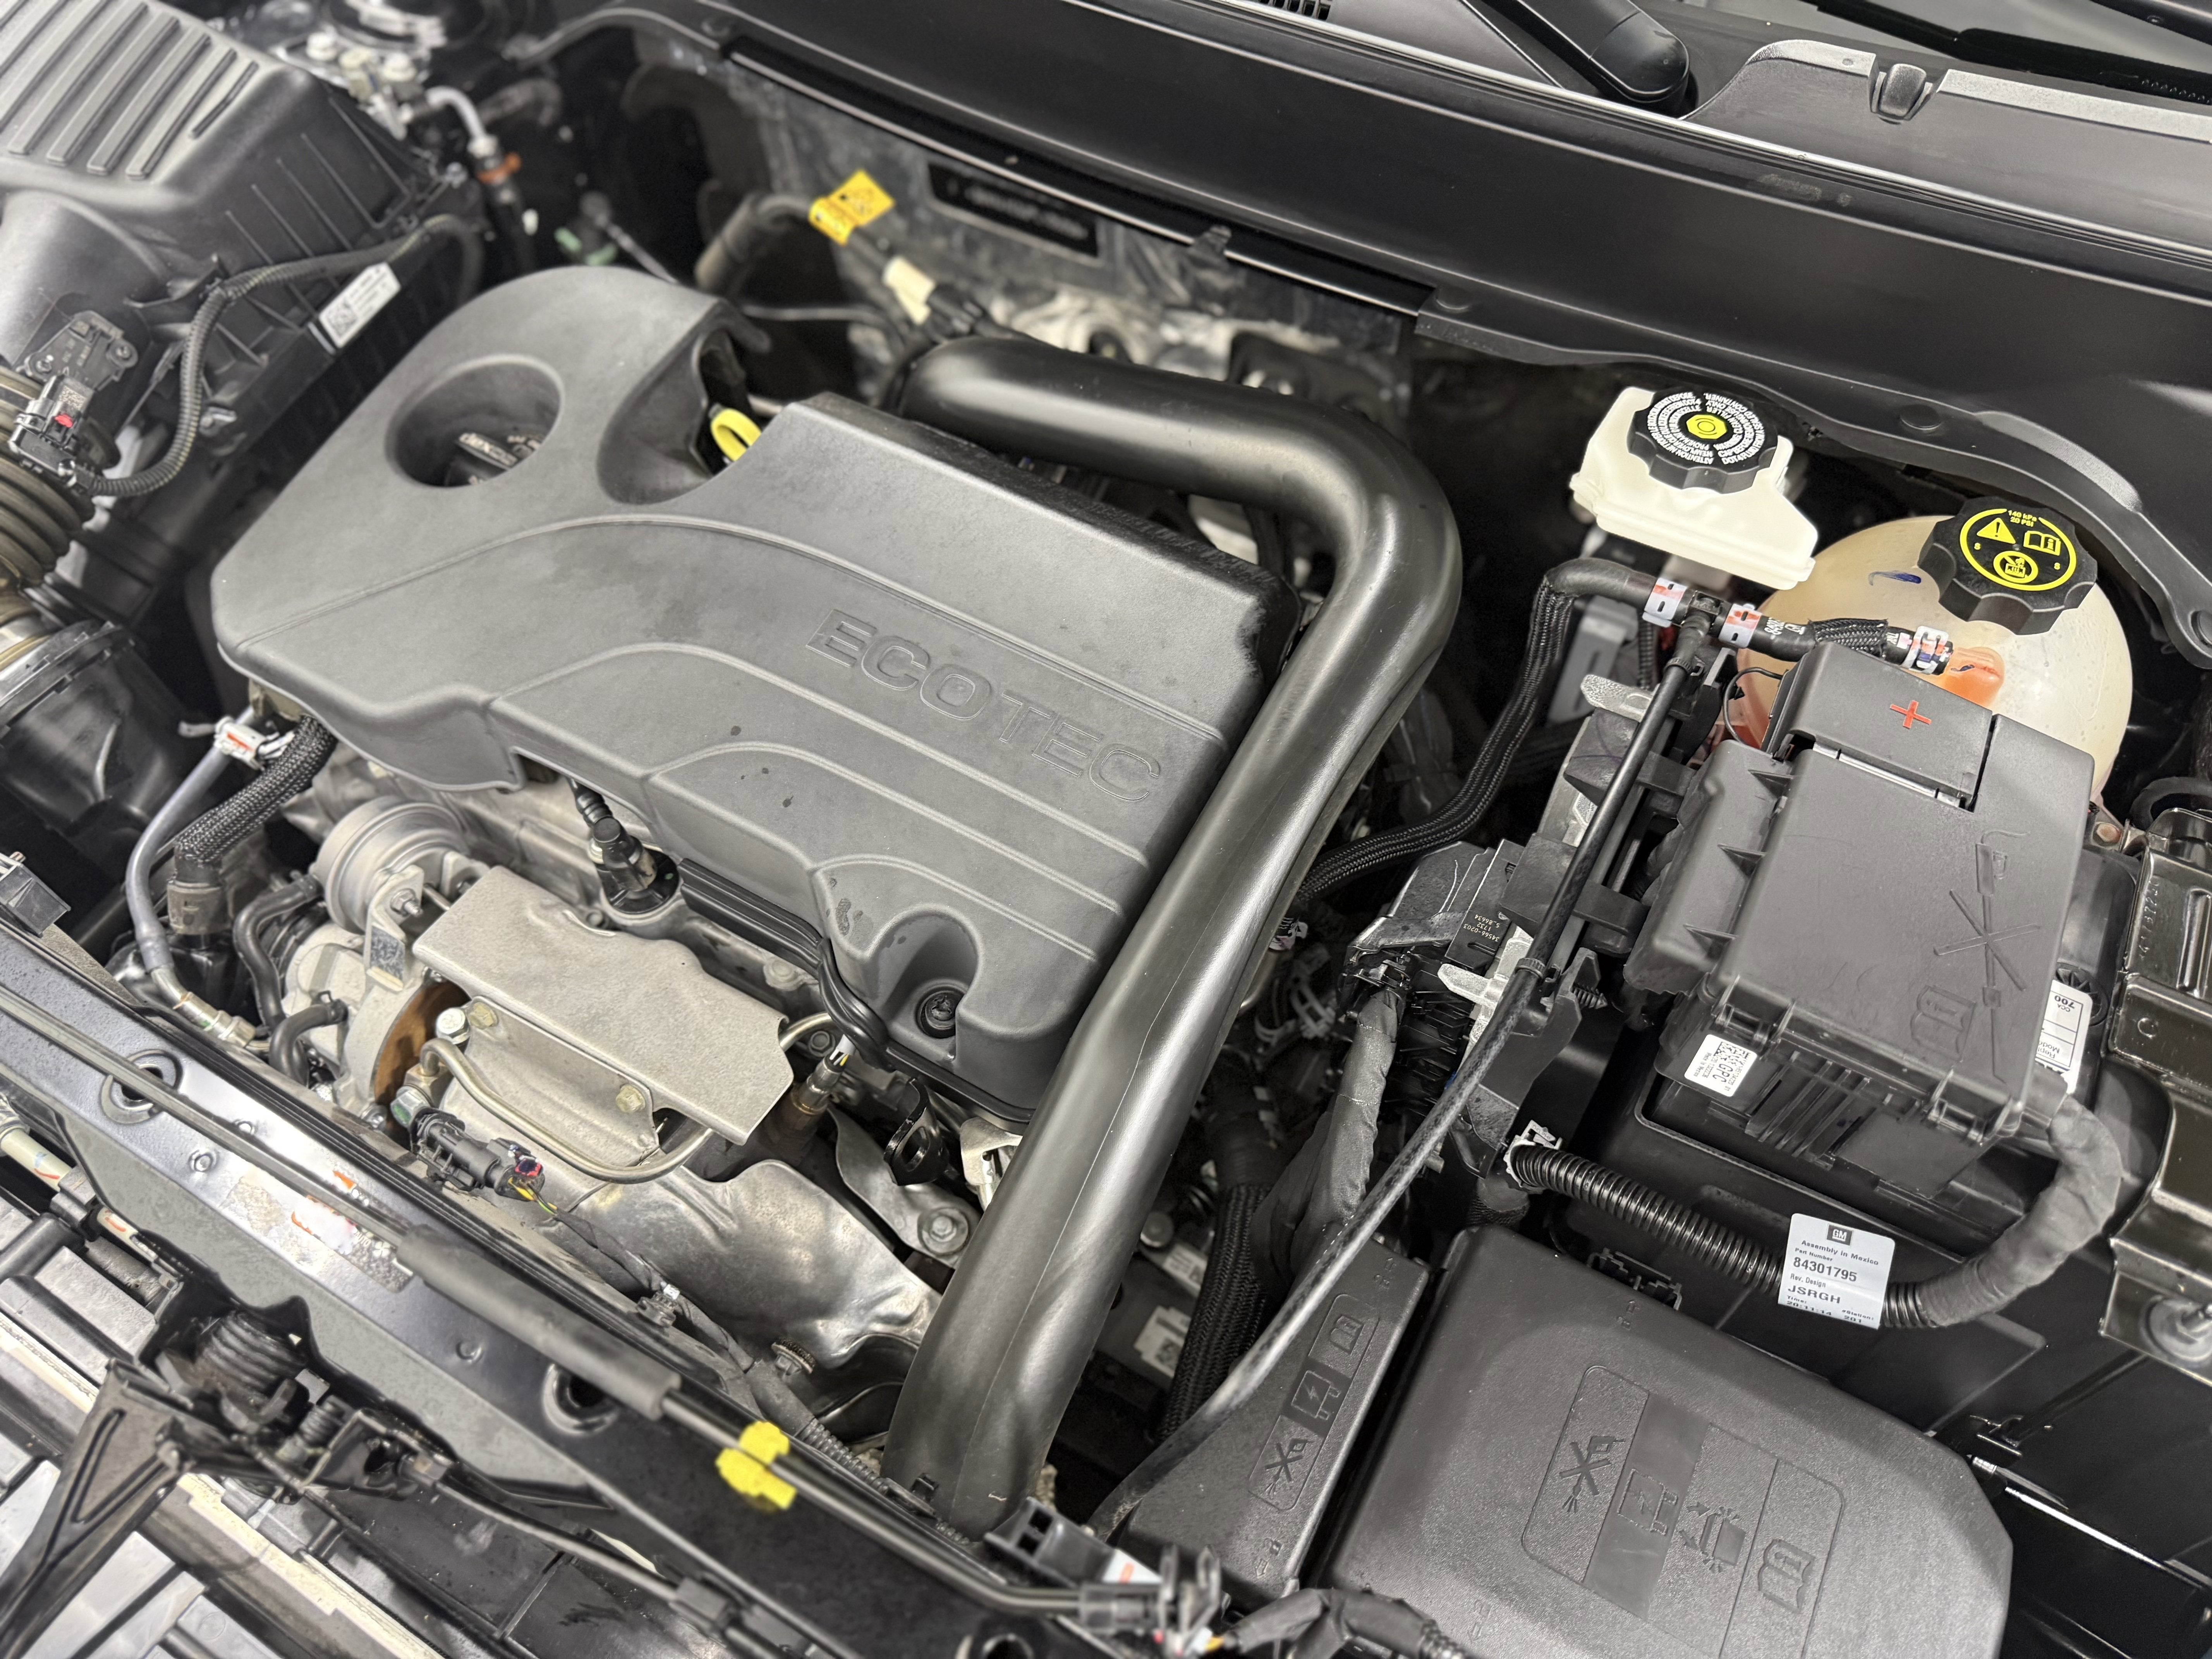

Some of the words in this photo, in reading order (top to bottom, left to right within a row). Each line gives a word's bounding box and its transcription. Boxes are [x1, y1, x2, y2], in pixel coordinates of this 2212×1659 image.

[1705, 399, 1727, 410] ONLY
[1724, 405, 1741, 416] USE
[1706, 406, 1733, 419] FILLER
[1721, 454, 1742, 464] DOT
[1742, 410, 1764, 429] SEALED
[2021, 519, 2034, 527] PSI
[805, 609, 1161, 802] ECOTEC
[1463, 924, 1499, 942] 34566-0203
[1477, 922, 1491, 931] 1732
[2054, 995, 2075, 1009] 700
[1711, 1063, 1734, 1083] GPC
[1832, 1228, 1847, 1241] GM
[1802, 1240, 1838, 1255] Assembly
[1851, 1253, 1879, 1265] Mexico
[1809, 1252, 1833, 1262] Number
[1793, 1257, 1857, 1282] 84301795
[1790, 1273, 1803, 1282] Rev.
[1805, 1277, 1826, 1288] Design
[1787, 1295, 1807, 1304] Time:
[1788, 1285, 1841, 1304] JSRGH
